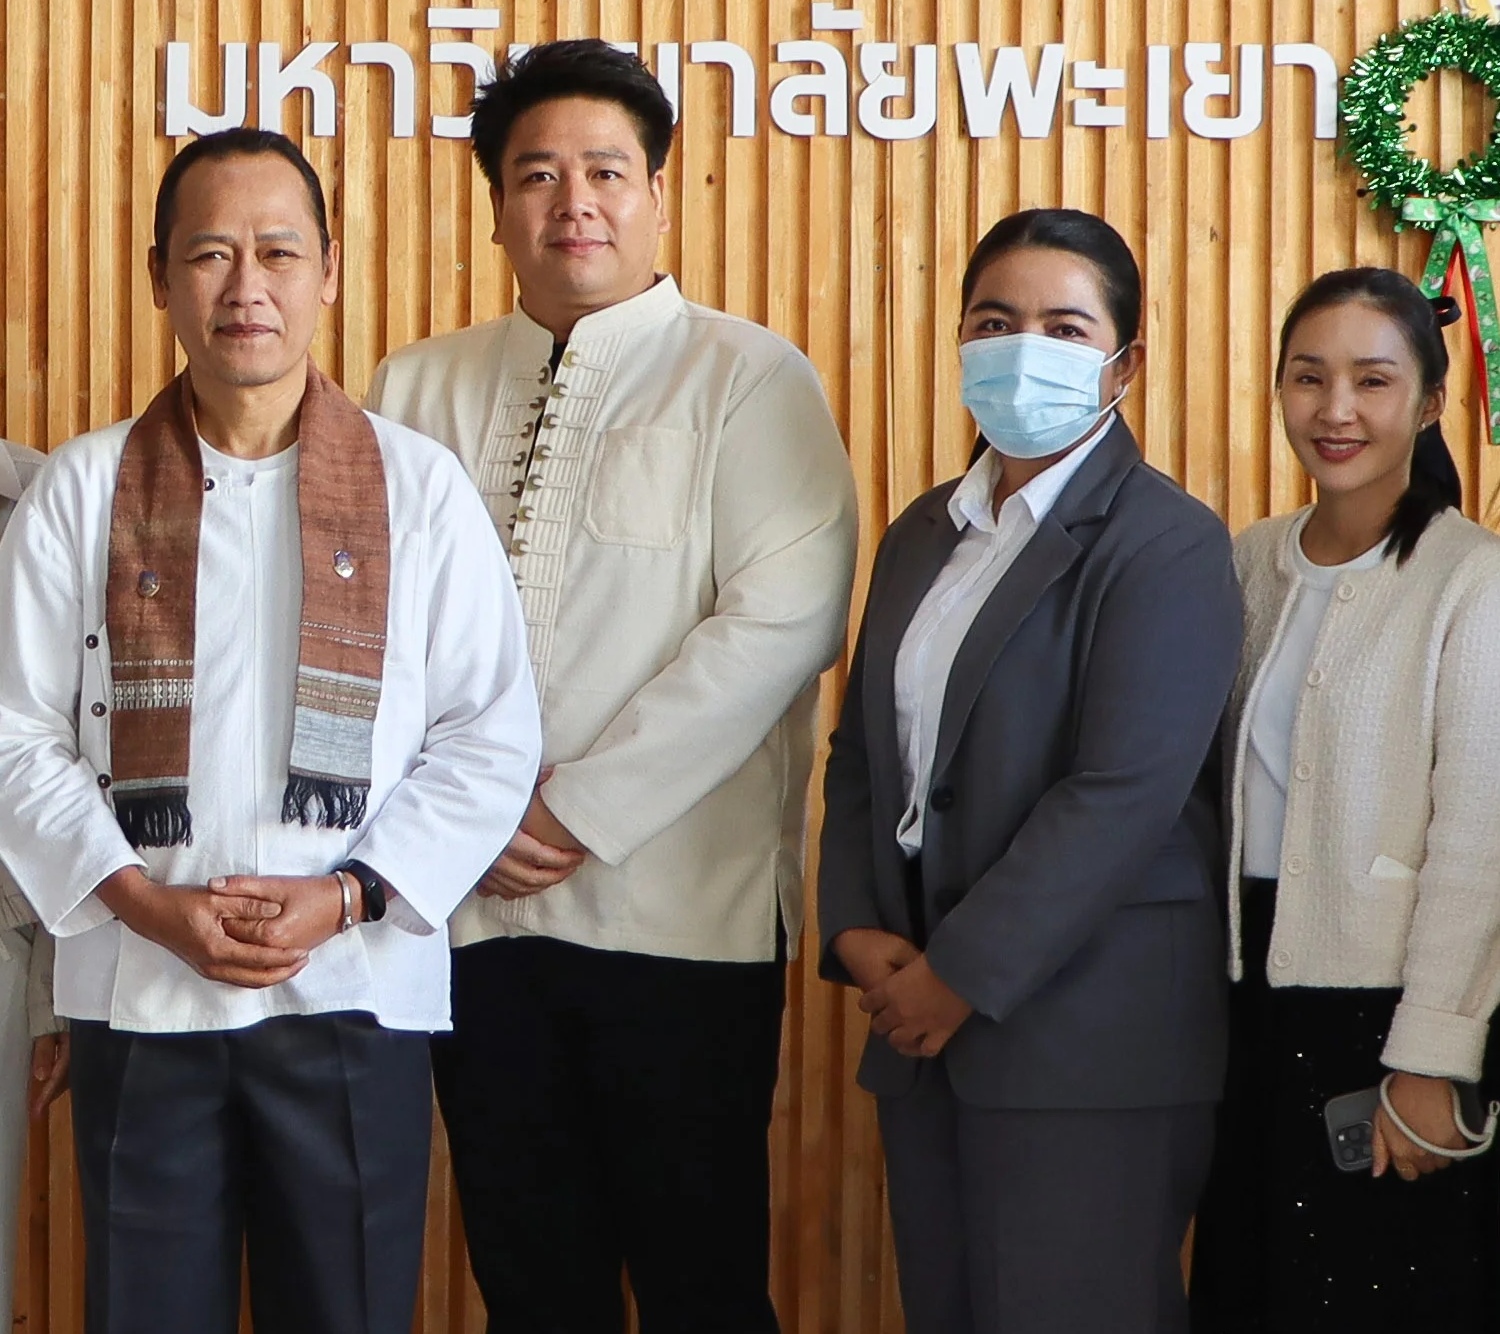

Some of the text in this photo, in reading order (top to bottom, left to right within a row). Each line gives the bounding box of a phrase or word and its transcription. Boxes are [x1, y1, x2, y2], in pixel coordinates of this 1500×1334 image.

[165, 2, 1338, 141] มหาวิาลัยพะเยา
